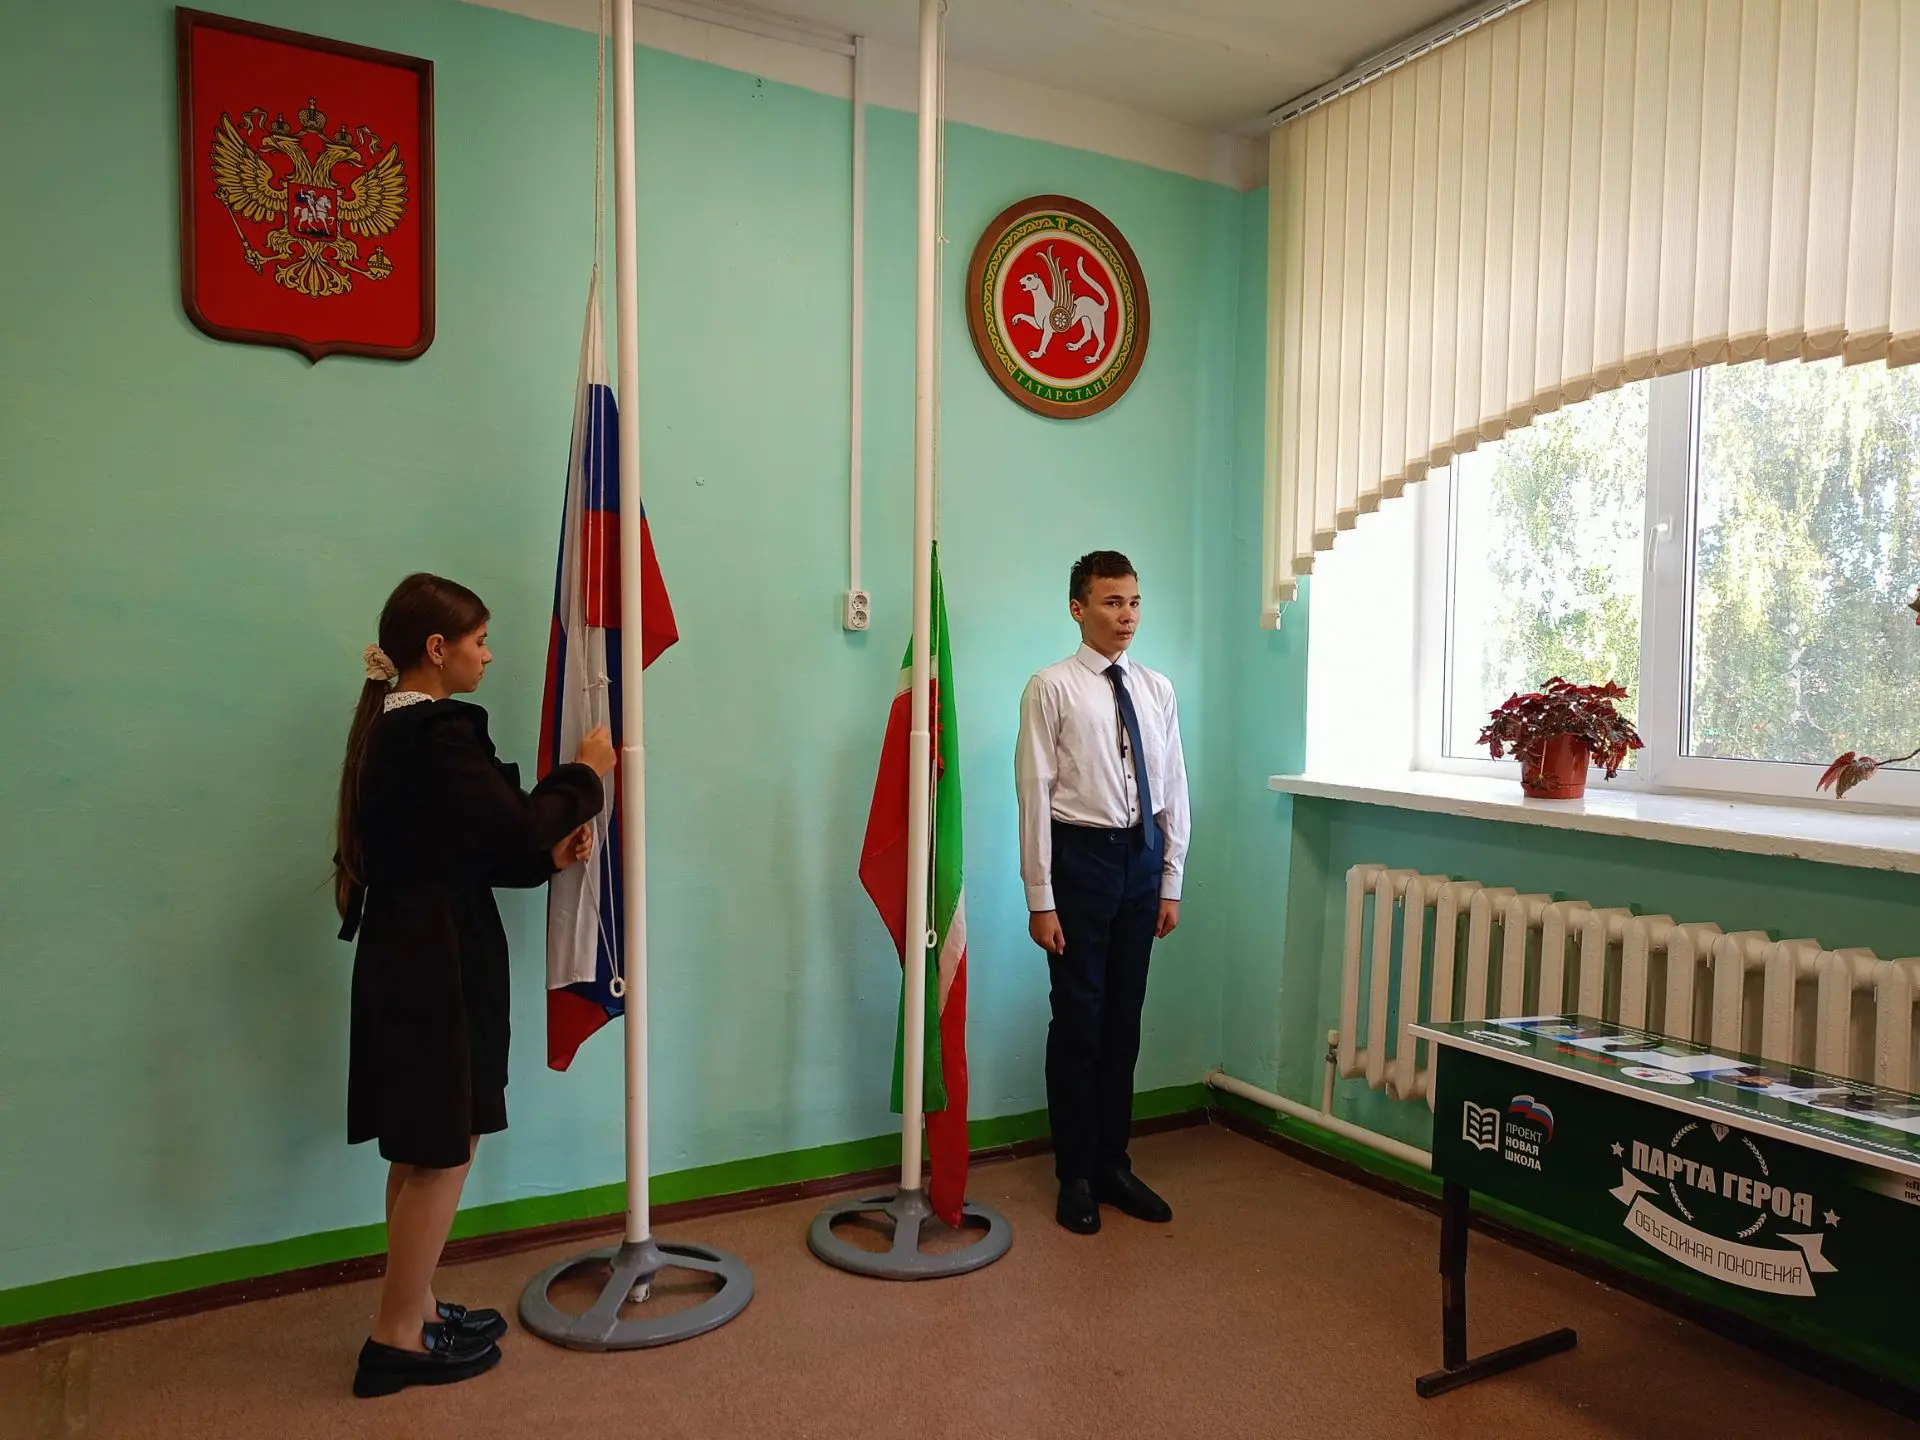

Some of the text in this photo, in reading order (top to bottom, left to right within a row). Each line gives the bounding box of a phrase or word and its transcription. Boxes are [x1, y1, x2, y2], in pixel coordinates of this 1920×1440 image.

[1017, 372, 1102, 401] ТАТАРСТАН
[1505, 1122, 1543, 1144] ПРОЕКТ
[1505, 1135, 1539, 1156] НОВАЯ
[1505, 1149, 1541, 1171] ШКОЛА
[1632, 1140, 1813, 1228] ПАРТА ГЕРОЯ
[1717, 1251, 1802, 1284] ПОКОЛЕНИЯ
